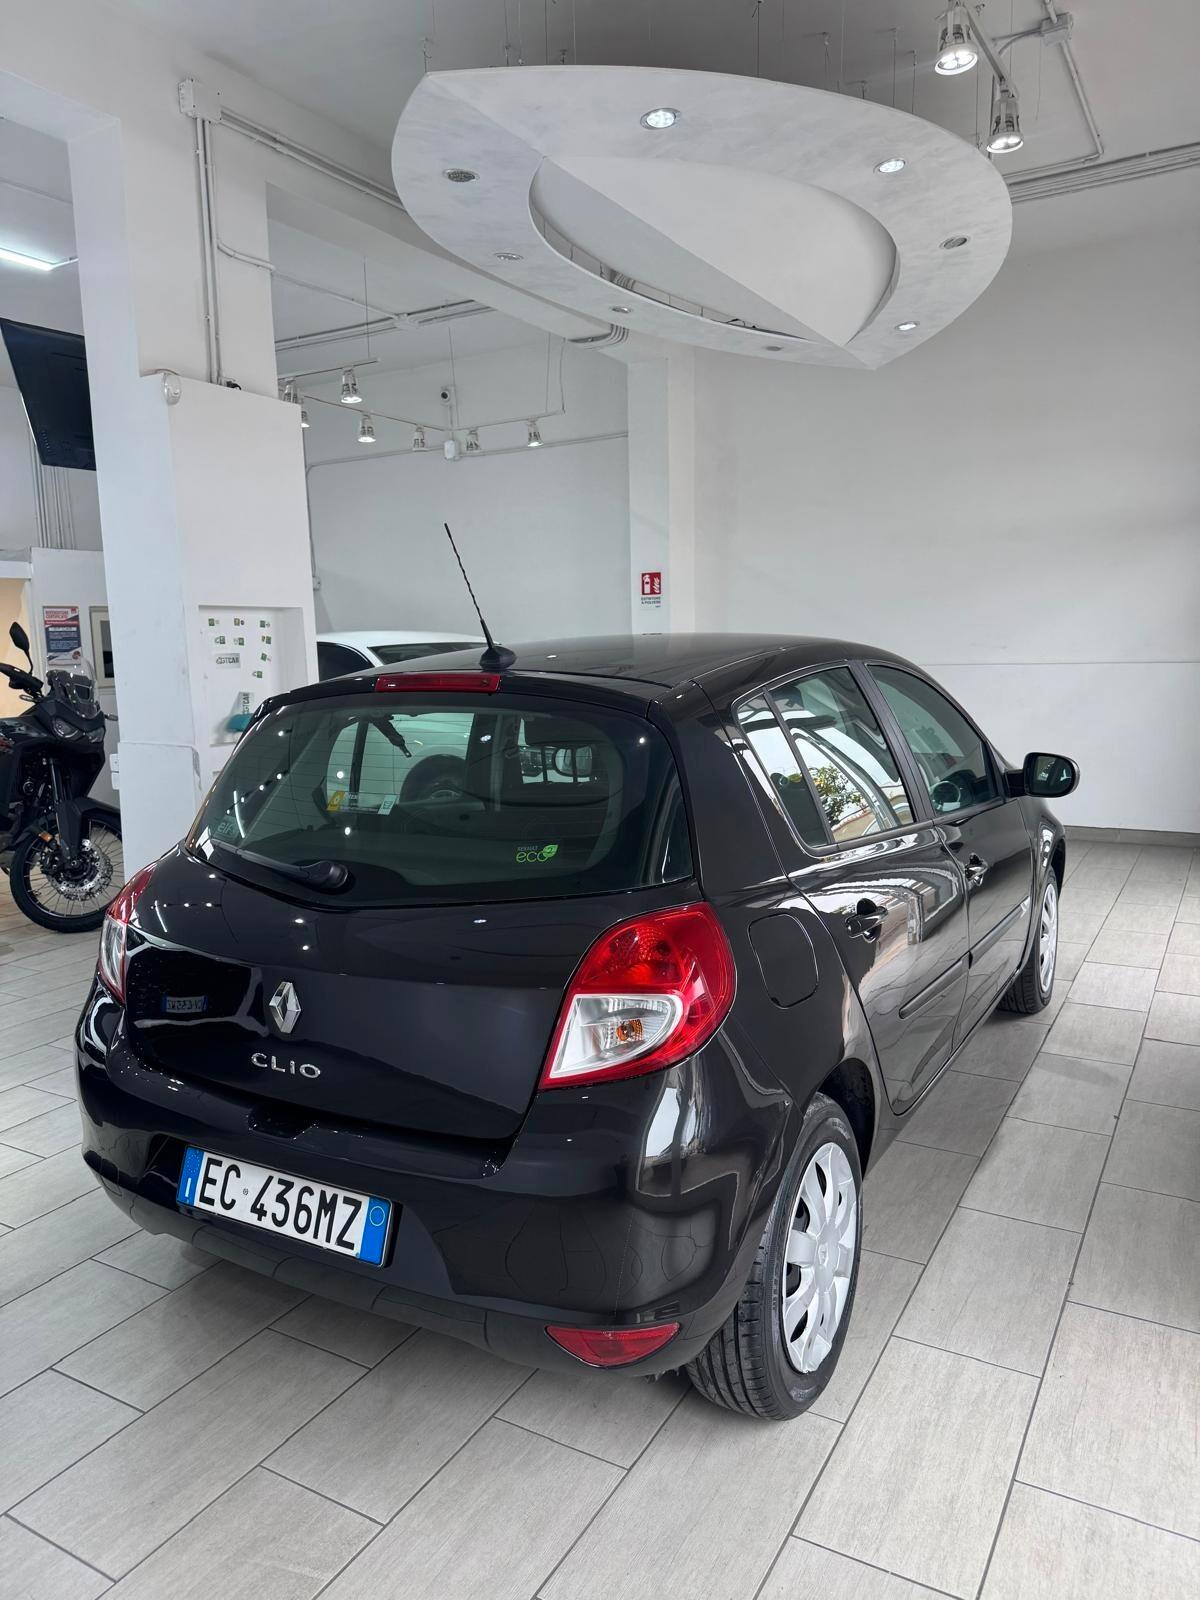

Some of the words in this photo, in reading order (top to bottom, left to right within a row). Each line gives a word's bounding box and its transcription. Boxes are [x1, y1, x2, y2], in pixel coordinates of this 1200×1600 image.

[251, 1052, 321, 1079] CLIO
[199, 1157, 241, 1211] EC
[250, 1175, 363, 1251] 436MZ
